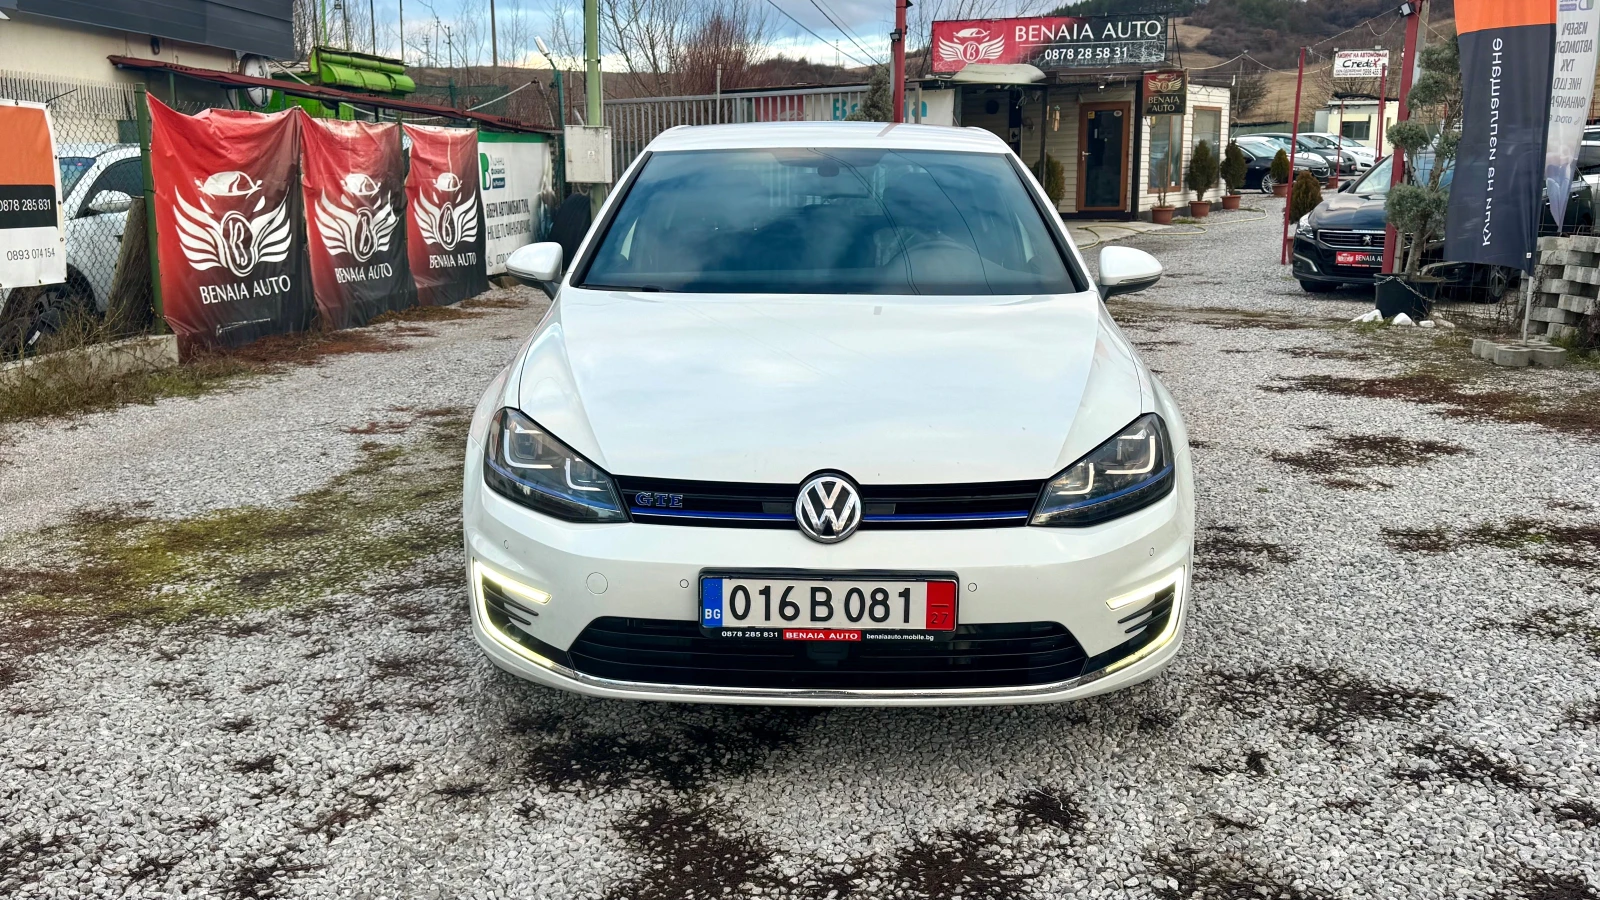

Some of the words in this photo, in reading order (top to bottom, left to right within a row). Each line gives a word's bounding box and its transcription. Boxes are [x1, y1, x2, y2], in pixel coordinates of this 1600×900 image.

[1015, 23, 1094, 42] BENAIA
[1101, 20, 1162, 39] AUTO
[1044, 49, 1074, 60] 0878
[1077, 48, 1092, 60] 28
[1095, 47, 1110, 59] 58
[1113, 46, 1128, 58] 31
[1148, 96, 1180, 104] BENAIA
[1151, 104, 1175, 112] AUTO
[21, 199, 38, 211] 285
[38, 199, 51, 210] 831
[6, 249, 30, 261] 0893
[31, 248, 43, 259] 074
[429, 254, 457, 269] BENAIA
[457, 252, 477, 266] AUTO
[334, 266, 366, 284] BENAIA
[368, 262, 393, 279] AUTO
[199, 282, 250, 305] BENAIA
[253, 274, 291, 298] AUTO
[635, 491, 684, 508] GTE
[704, 608, 721, 620] BG
[930, 611, 949, 625] 27
[721, 630, 743, 638] 0878
[866, 633, 935, 642] benaiaauto.mobile.bg
